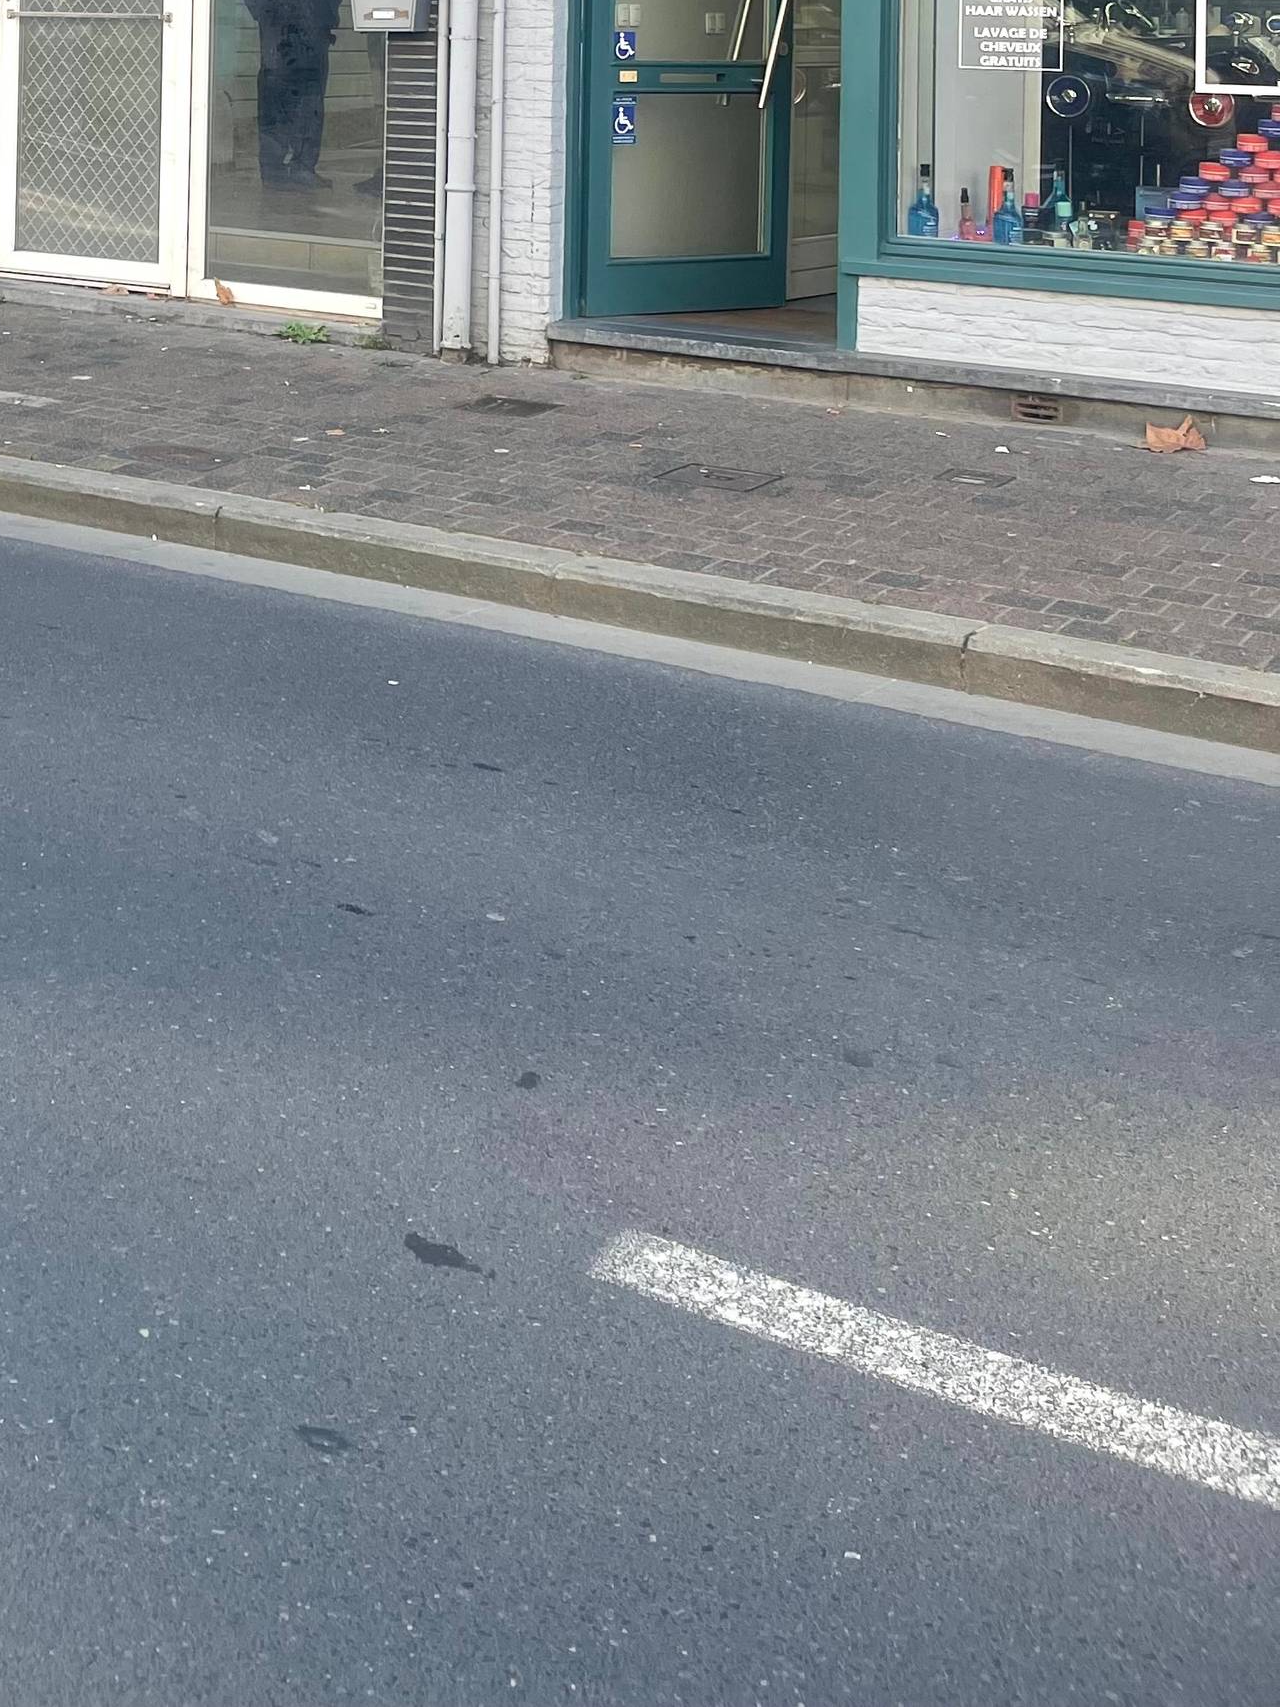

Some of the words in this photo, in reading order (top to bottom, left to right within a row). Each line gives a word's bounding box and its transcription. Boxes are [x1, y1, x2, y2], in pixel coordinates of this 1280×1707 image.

[965, 5, 1003, 17] HAAR
[1005, 6, 1058, 17] WASSEN
[973, 27, 1027, 39] LAVAGE
[1029, 28, 1048, 39] DE
[979, 41, 1041, 53] CHEVEUX
[979, 55, 1042, 68] GRATUITS
